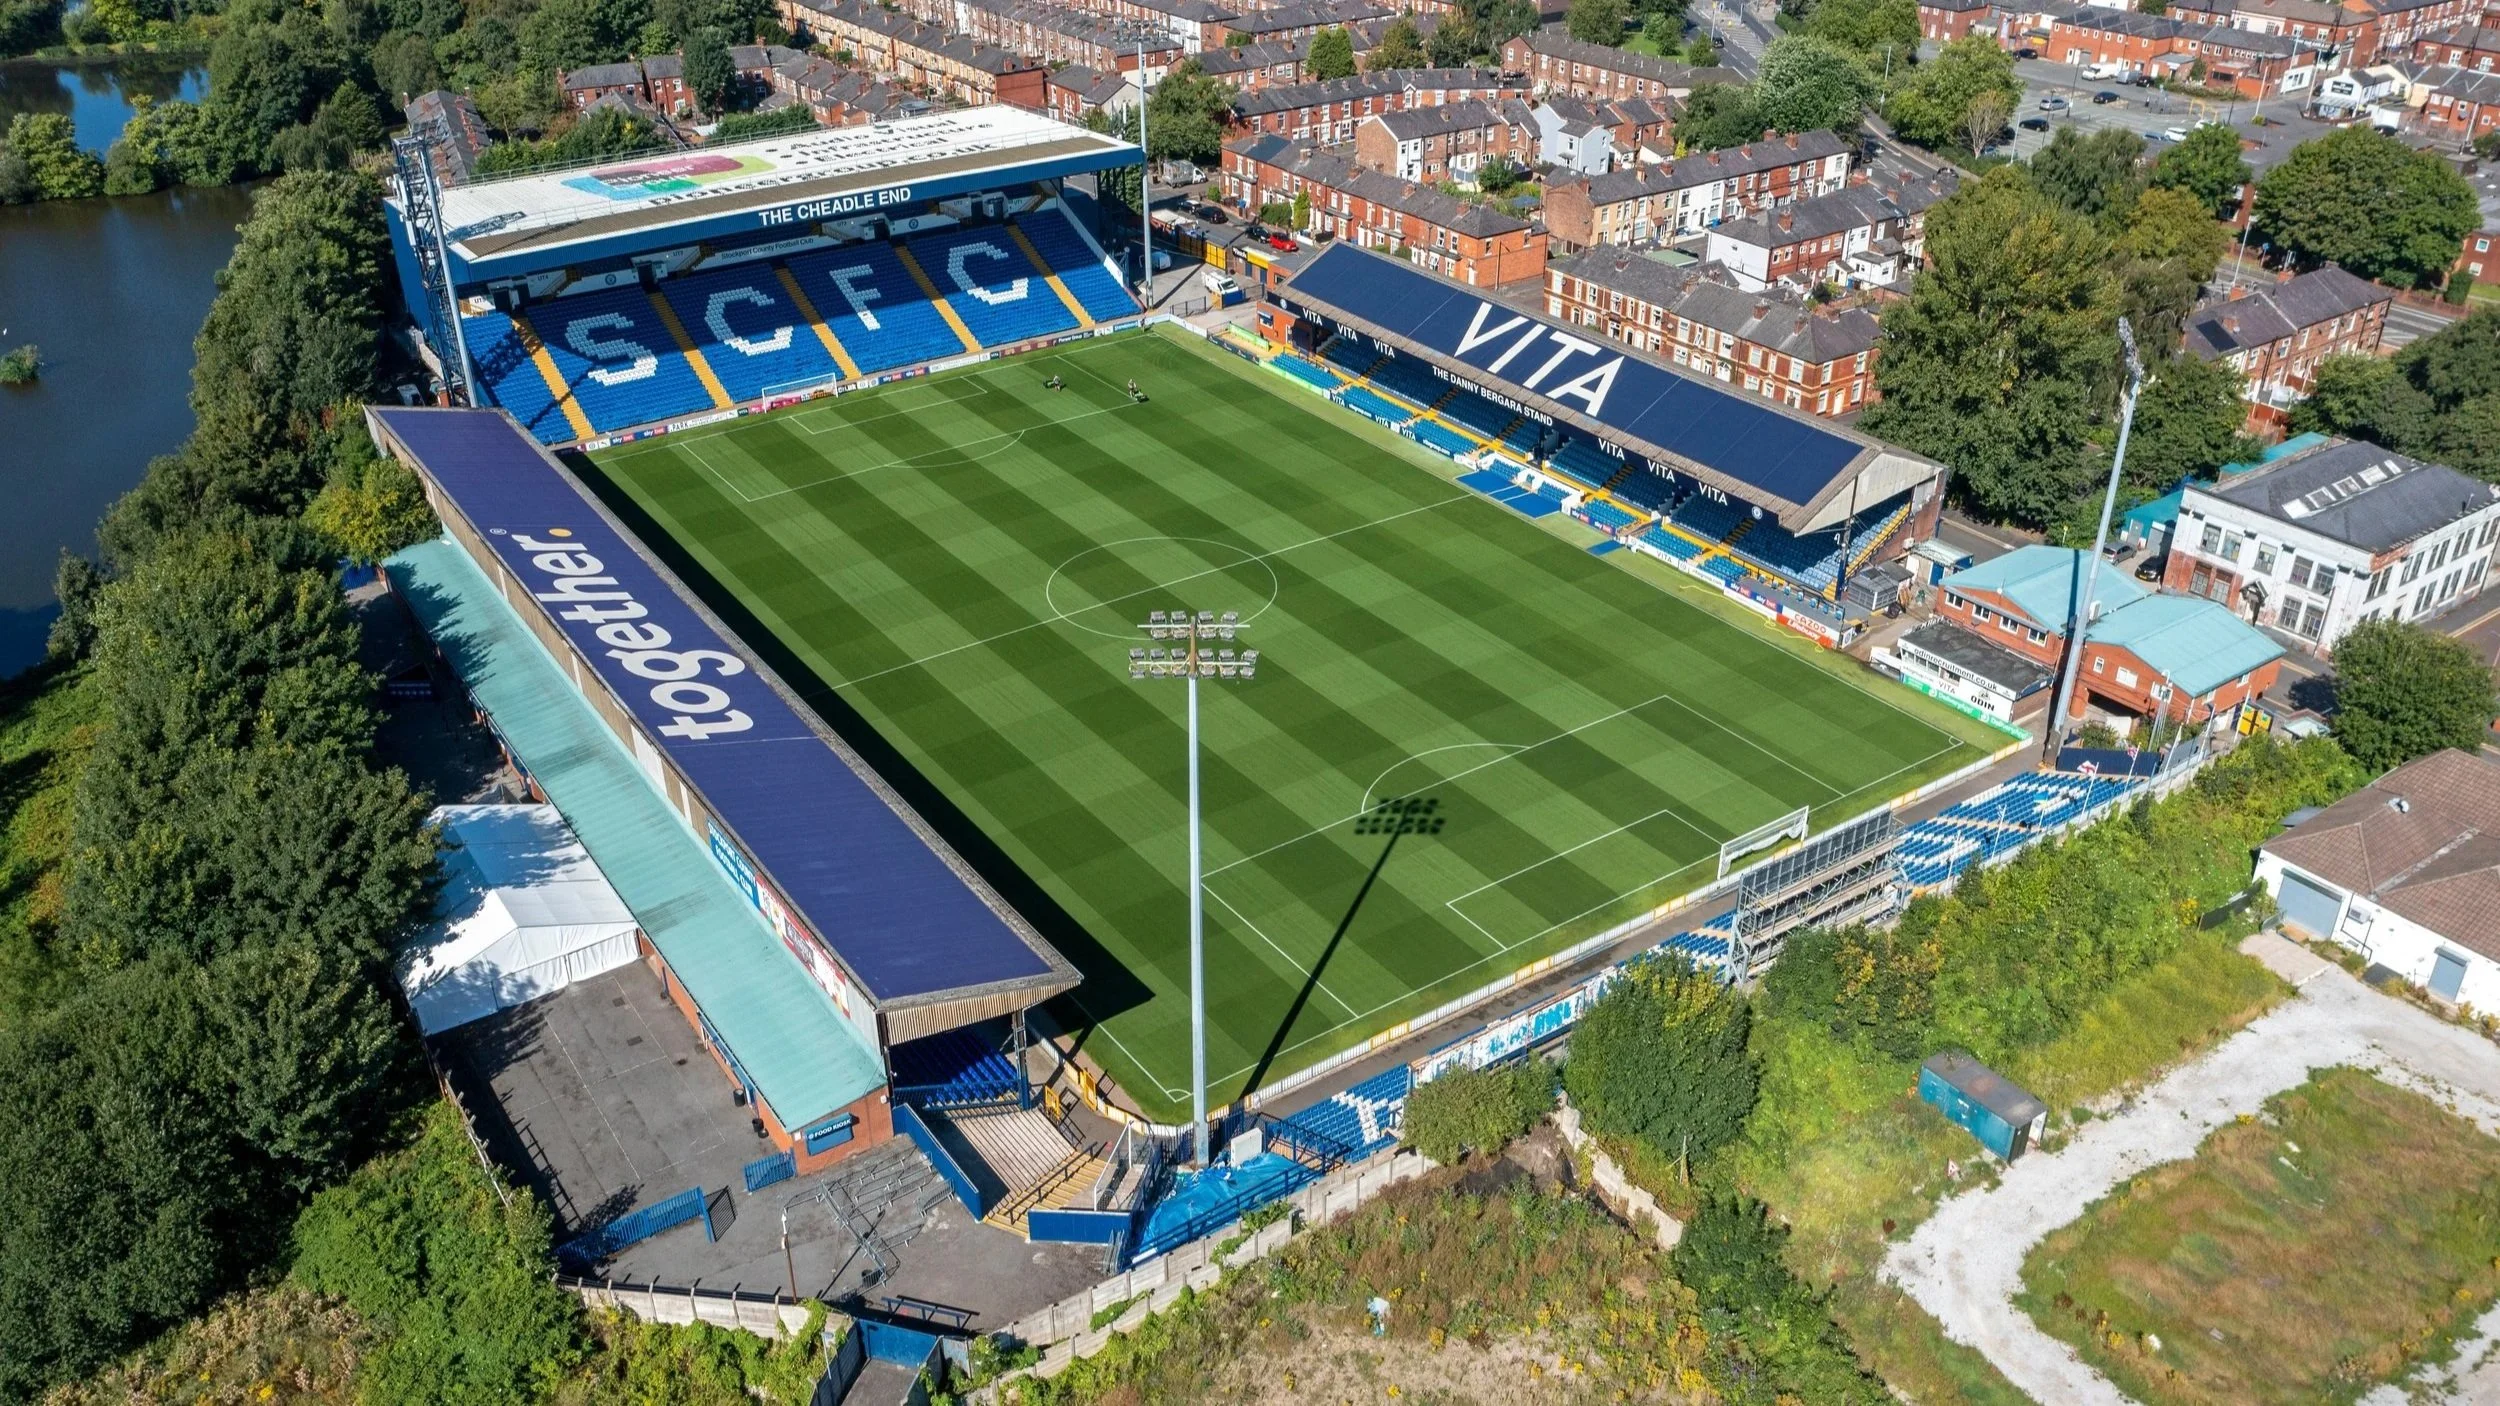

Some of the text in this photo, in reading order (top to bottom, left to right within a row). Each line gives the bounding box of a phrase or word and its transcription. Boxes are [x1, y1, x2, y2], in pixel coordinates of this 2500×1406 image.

[758, 187, 912, 227] THE CHEADLE END
[753, 245, 774, 254] County
[775, 240, 800, 250] Football
[1302, 307, 1323, 327] VITA
[1337, 322, 1358, 342] VITA
[1373, 338, 1395, 359] VITA
[1453, 301, 1625, 417] VITA
[1332, 395, 1346, 407] VITA
[1432, 365, 1553, 427] THE DANNY BERGARA STAND
[1374, 415, 1390, 429] VITA
[612, 436, 622, 444] sky
[1401, 428, 1416, 441] VITA
[1598, 437, 1625, 461] VITA
[1647, 458, 1675, 483] VITA
[1699, 481, 1728, 506] VITA
[1656, 551, 1672, 563] VITA
[1730, 582, 1751, 597] sky bet
[1756, 594, 1777, 610] sky bet
[1794, 613, 1827, 634] CAZOO
[511, 533, 754, 740] together
[1914, 647, 1998, 692] odinrecruitment.co.uk
[1938, 681, 1956, 694] VITA
[1970, 695, 1995, 712] ODIN
[736, 855, 756, 887] COUNTY
[739, 874, 754, 899] CLUB
[814, 1118, 852, 1138] FOOD KIOSK
